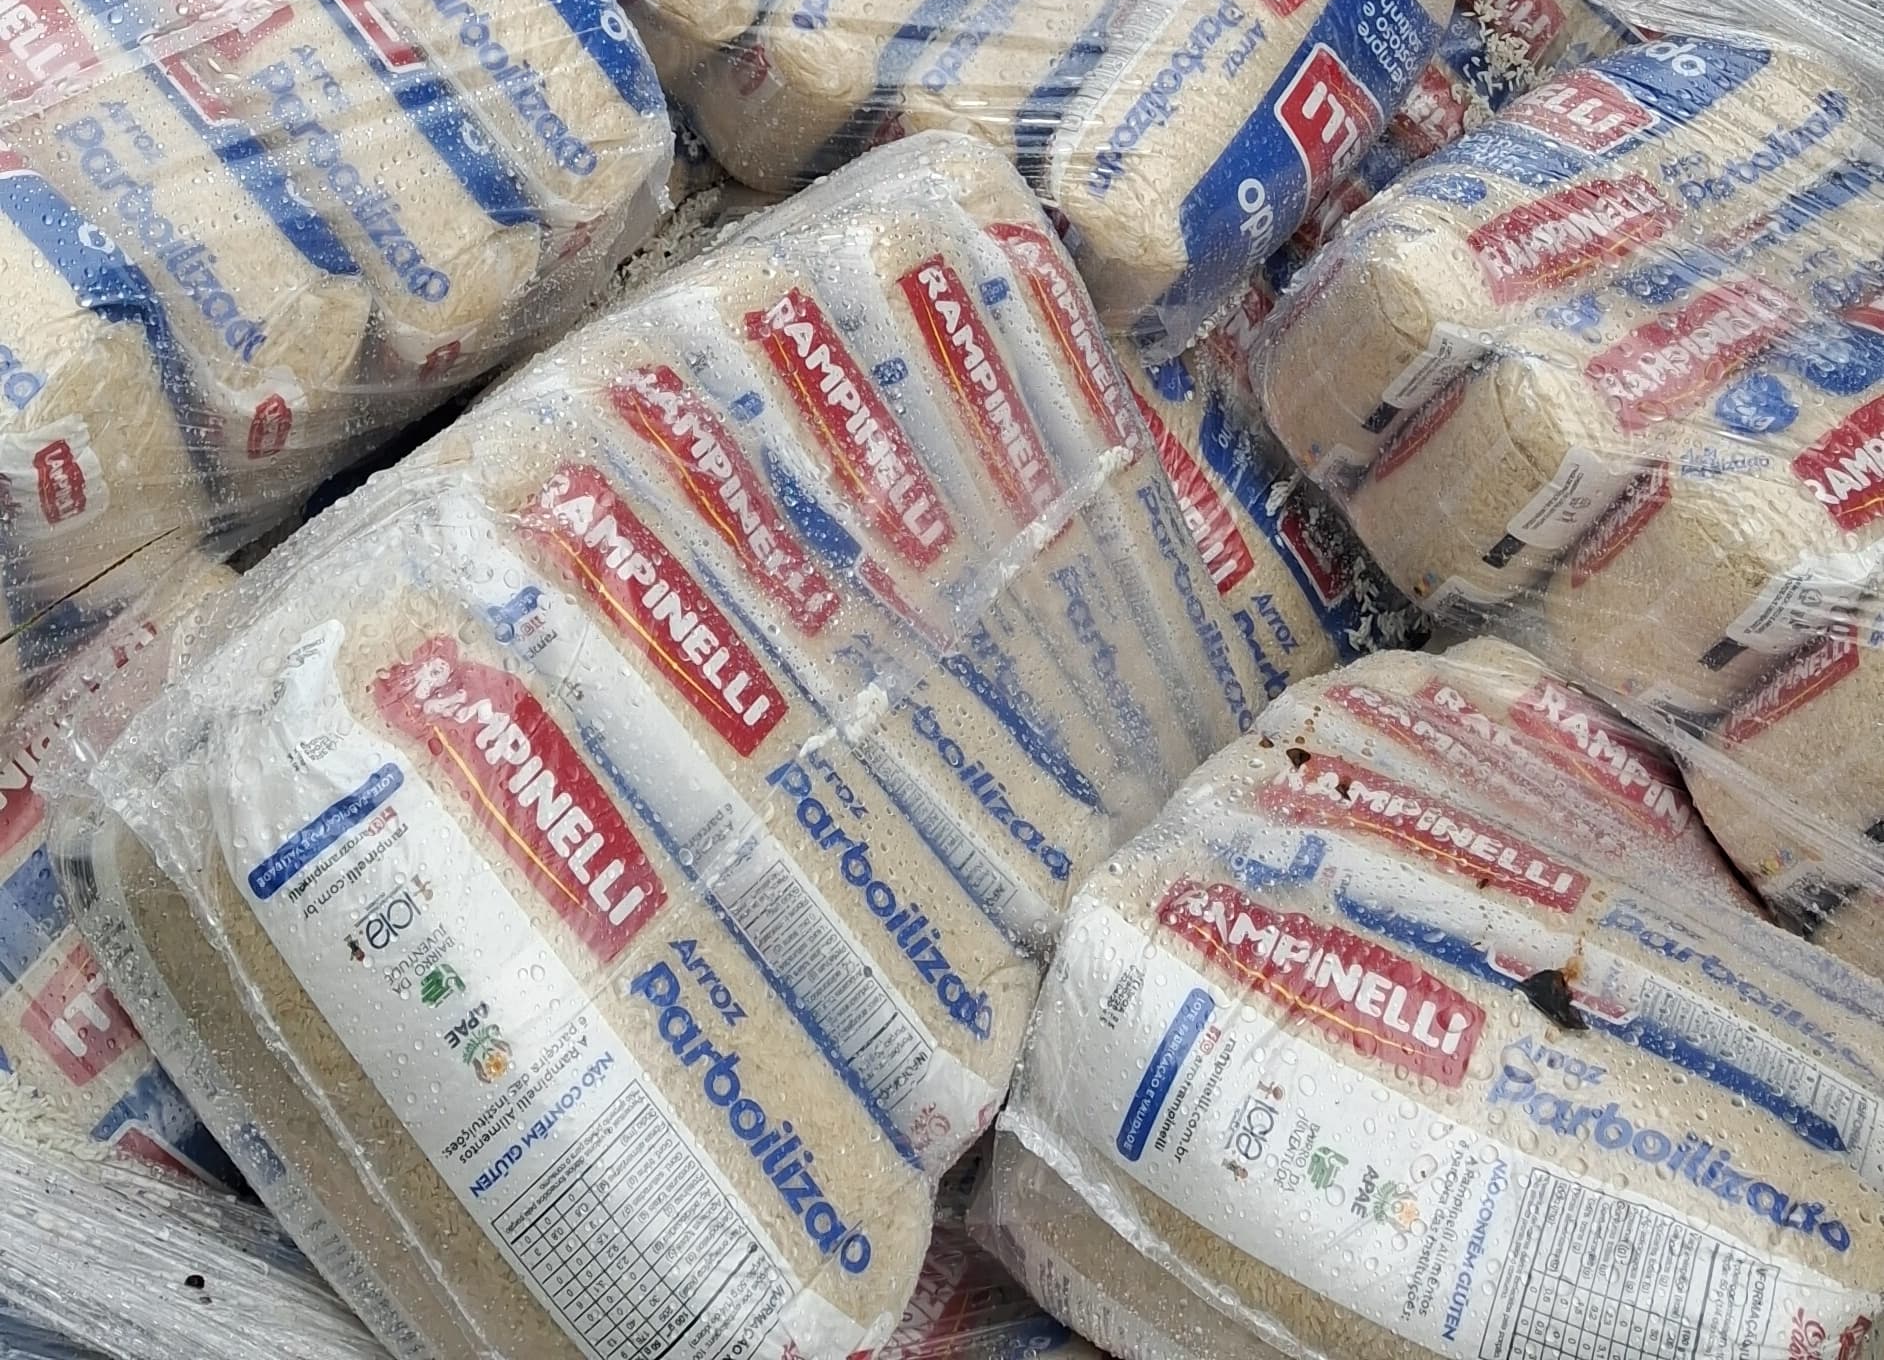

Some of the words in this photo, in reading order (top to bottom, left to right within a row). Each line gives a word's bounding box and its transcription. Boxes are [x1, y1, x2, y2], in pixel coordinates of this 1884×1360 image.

[1216, 13, 1272, 83] Arroz
[764, 295, 948, 550] RAMPINELLI
[540, 472, 773, 728] RAMPINELLI
[1252, 592, 1298, 654] Arroz
[296, 822, 415, 921] rampinelli.com.br
[379, 923, 452, 985] JUVENTUDE
[390, 975, 413, 997] DA
[410, 936, 458, 977] BAIRRO
[669, 939, 751, 1028] Arroz
[442, 999, 492, 1050] APAE
[525, 1020, 580, 1076] parceira
[505, 1071, 533, 1099] das
[511, 1041, 583, 1114] Rampinelli
[576, 1049, 617, 1090] NÃO
[1168, 1036, 1241, 1165] rampinelli.com.br
[439, 1090, 512, 1164] instituições:
[457, 1105, 520, 1169] Alimentos
[518, 1081, 587, 1152] CONTÉM
[630, 961, 874, 1277] Parboilizao
[1119, 1096, 1155, 1151] VALIDADE
[467, 1140, 528, 1203] GLÚTEN
[1284, 1173, 1300, 1194] DA
[1348, 1164, 1382, 1218] APAE
[1456, 1197, 1501, 1270] CONTÉM
[1436, 1271, 1479, 1342] GLÚTEN
